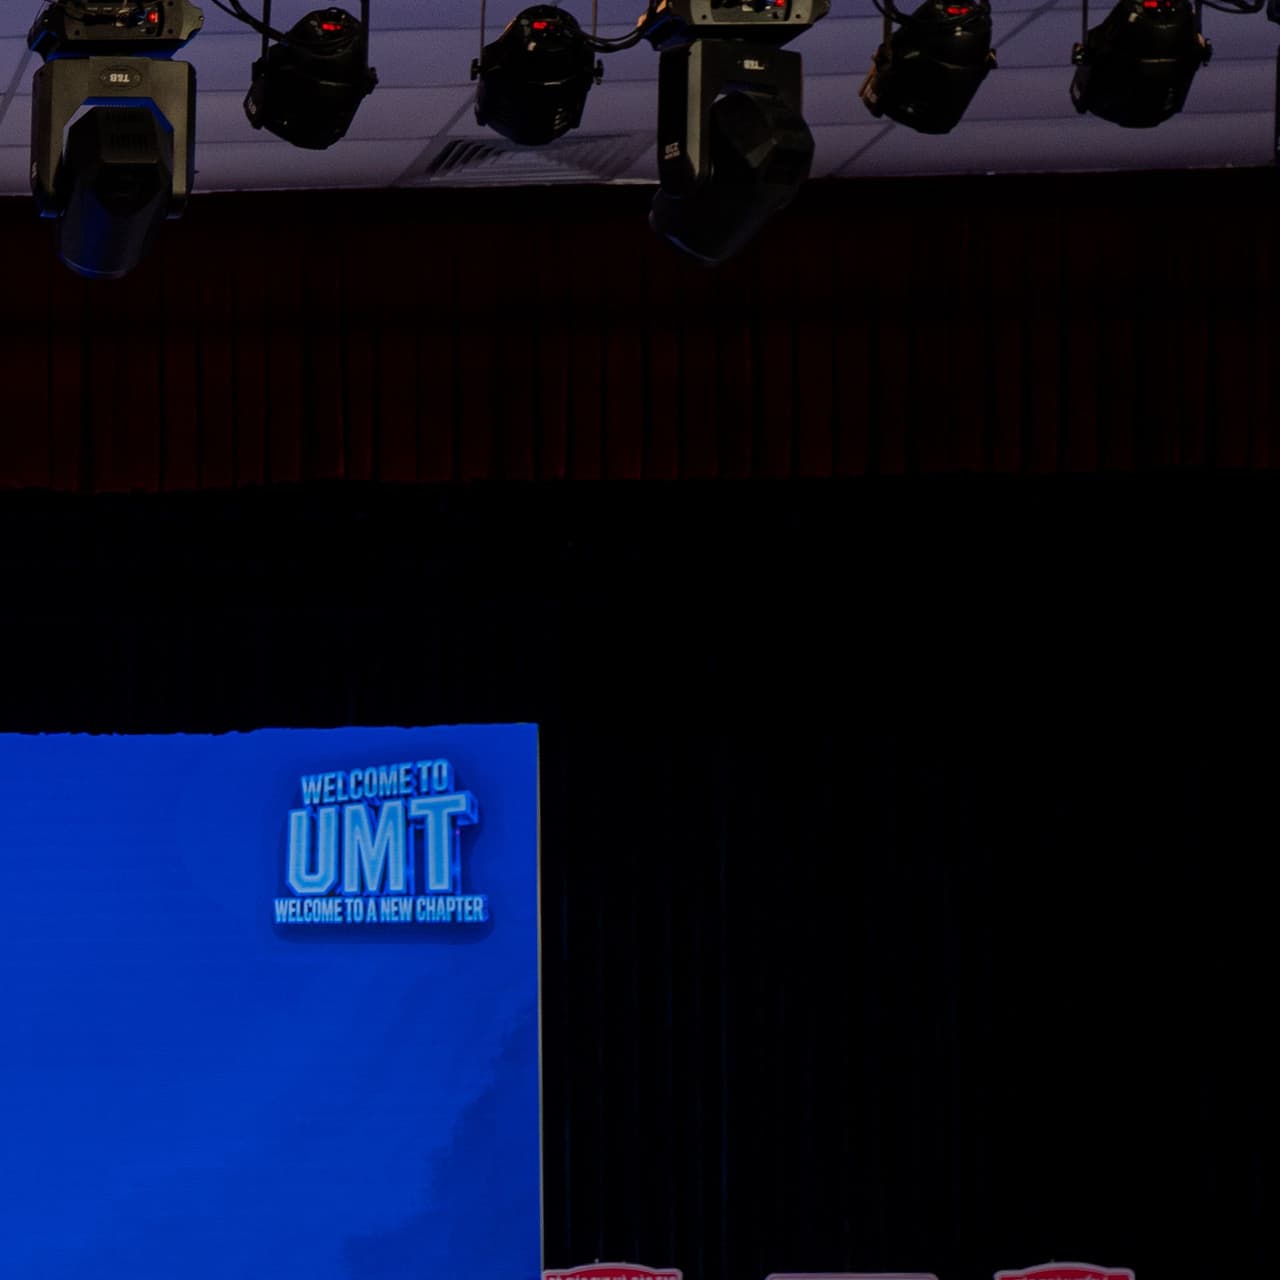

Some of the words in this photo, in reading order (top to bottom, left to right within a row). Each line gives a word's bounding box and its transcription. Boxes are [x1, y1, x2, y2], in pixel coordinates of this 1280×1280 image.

[110, 73, 130, 83] T&B
[301, 762, 414, 805] WELCOME
[416, 758, 451, 793] TO
[288, 793, 470, 895] UMT
[274, 897, 342, 923] WELCOME
[344, 898, 365, 922] TO
[365, 898, 378, 922] A
[380, 898, 414, 922] NEW
[416, 897, 486, 922] CHAPTER
